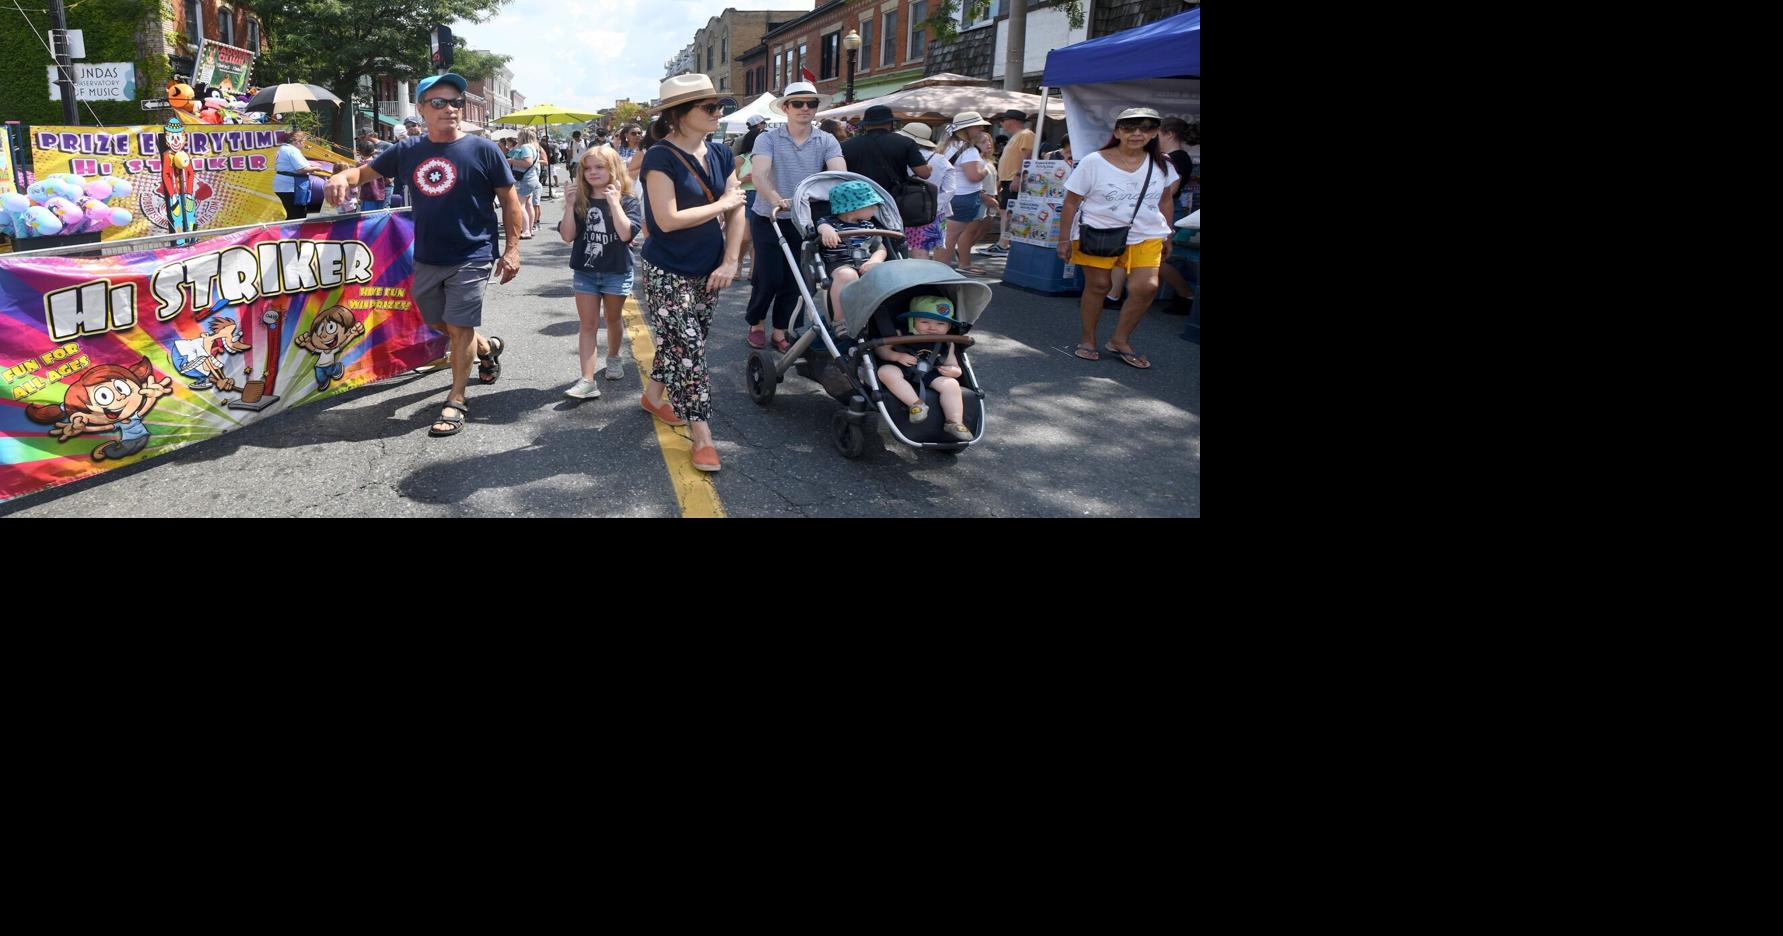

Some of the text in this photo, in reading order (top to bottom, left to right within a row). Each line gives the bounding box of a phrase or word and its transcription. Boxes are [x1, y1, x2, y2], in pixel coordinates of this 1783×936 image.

[80, 67, 118, 78] NDAS
[89, 88, 119, 96] MUSIC
[36, 130, 285, 155] PRIZE ERYTIM
[124, 155, 268, 174] STIKER
[1105, 190, 1160, 201] Canda
[151, 240, 373, 321] STRIKER
[360, 287, 405, 297] HAVE FUN
[2, 342, 80, 384] FUN FOR
[12, 354, 90, 400] ALL AGES
